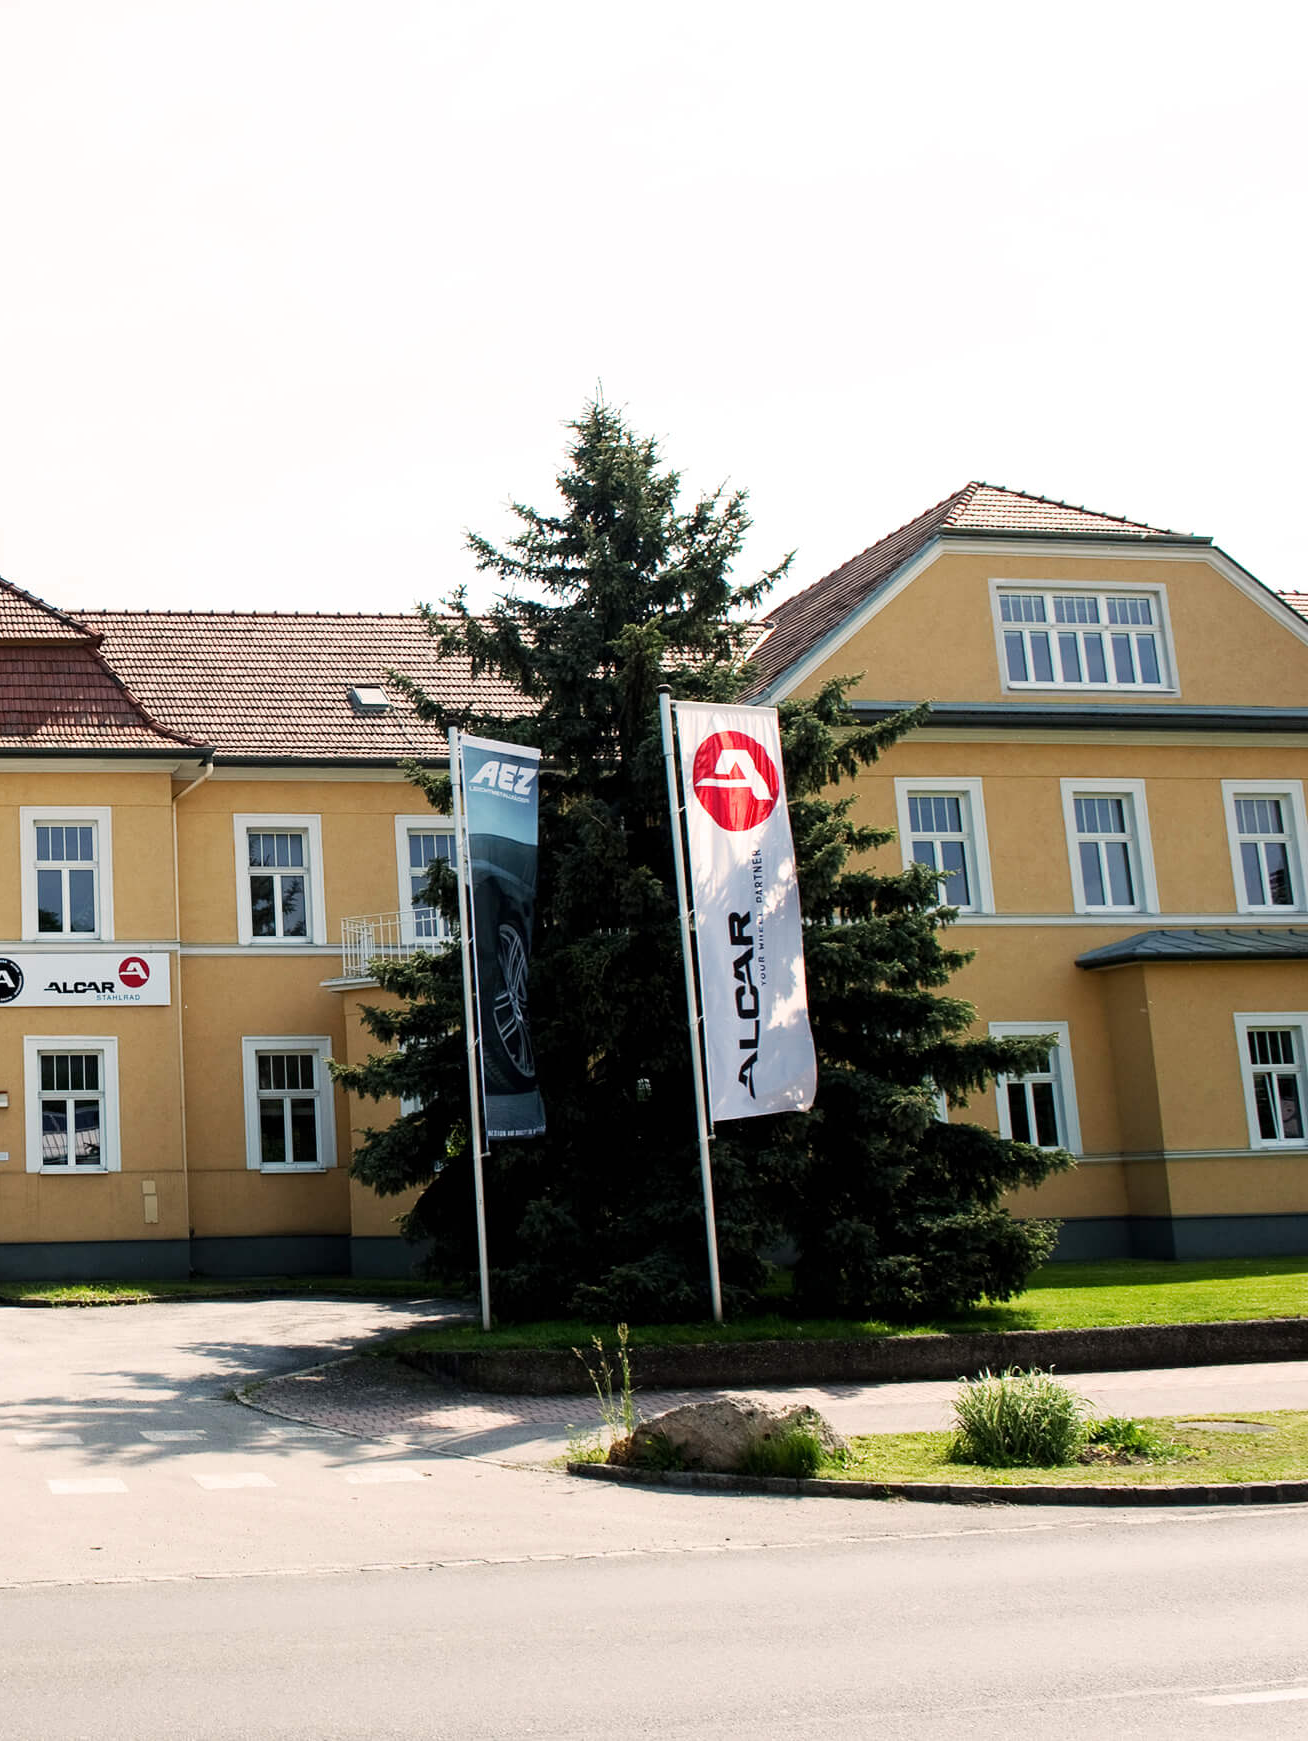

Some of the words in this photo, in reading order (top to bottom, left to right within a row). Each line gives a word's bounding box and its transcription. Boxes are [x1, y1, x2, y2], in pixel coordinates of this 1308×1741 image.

[469, 760, 539, 796] AEZ
[43, 981, 116, 994] ALCAR
[728, 910, 761, 1101] ALCAR
